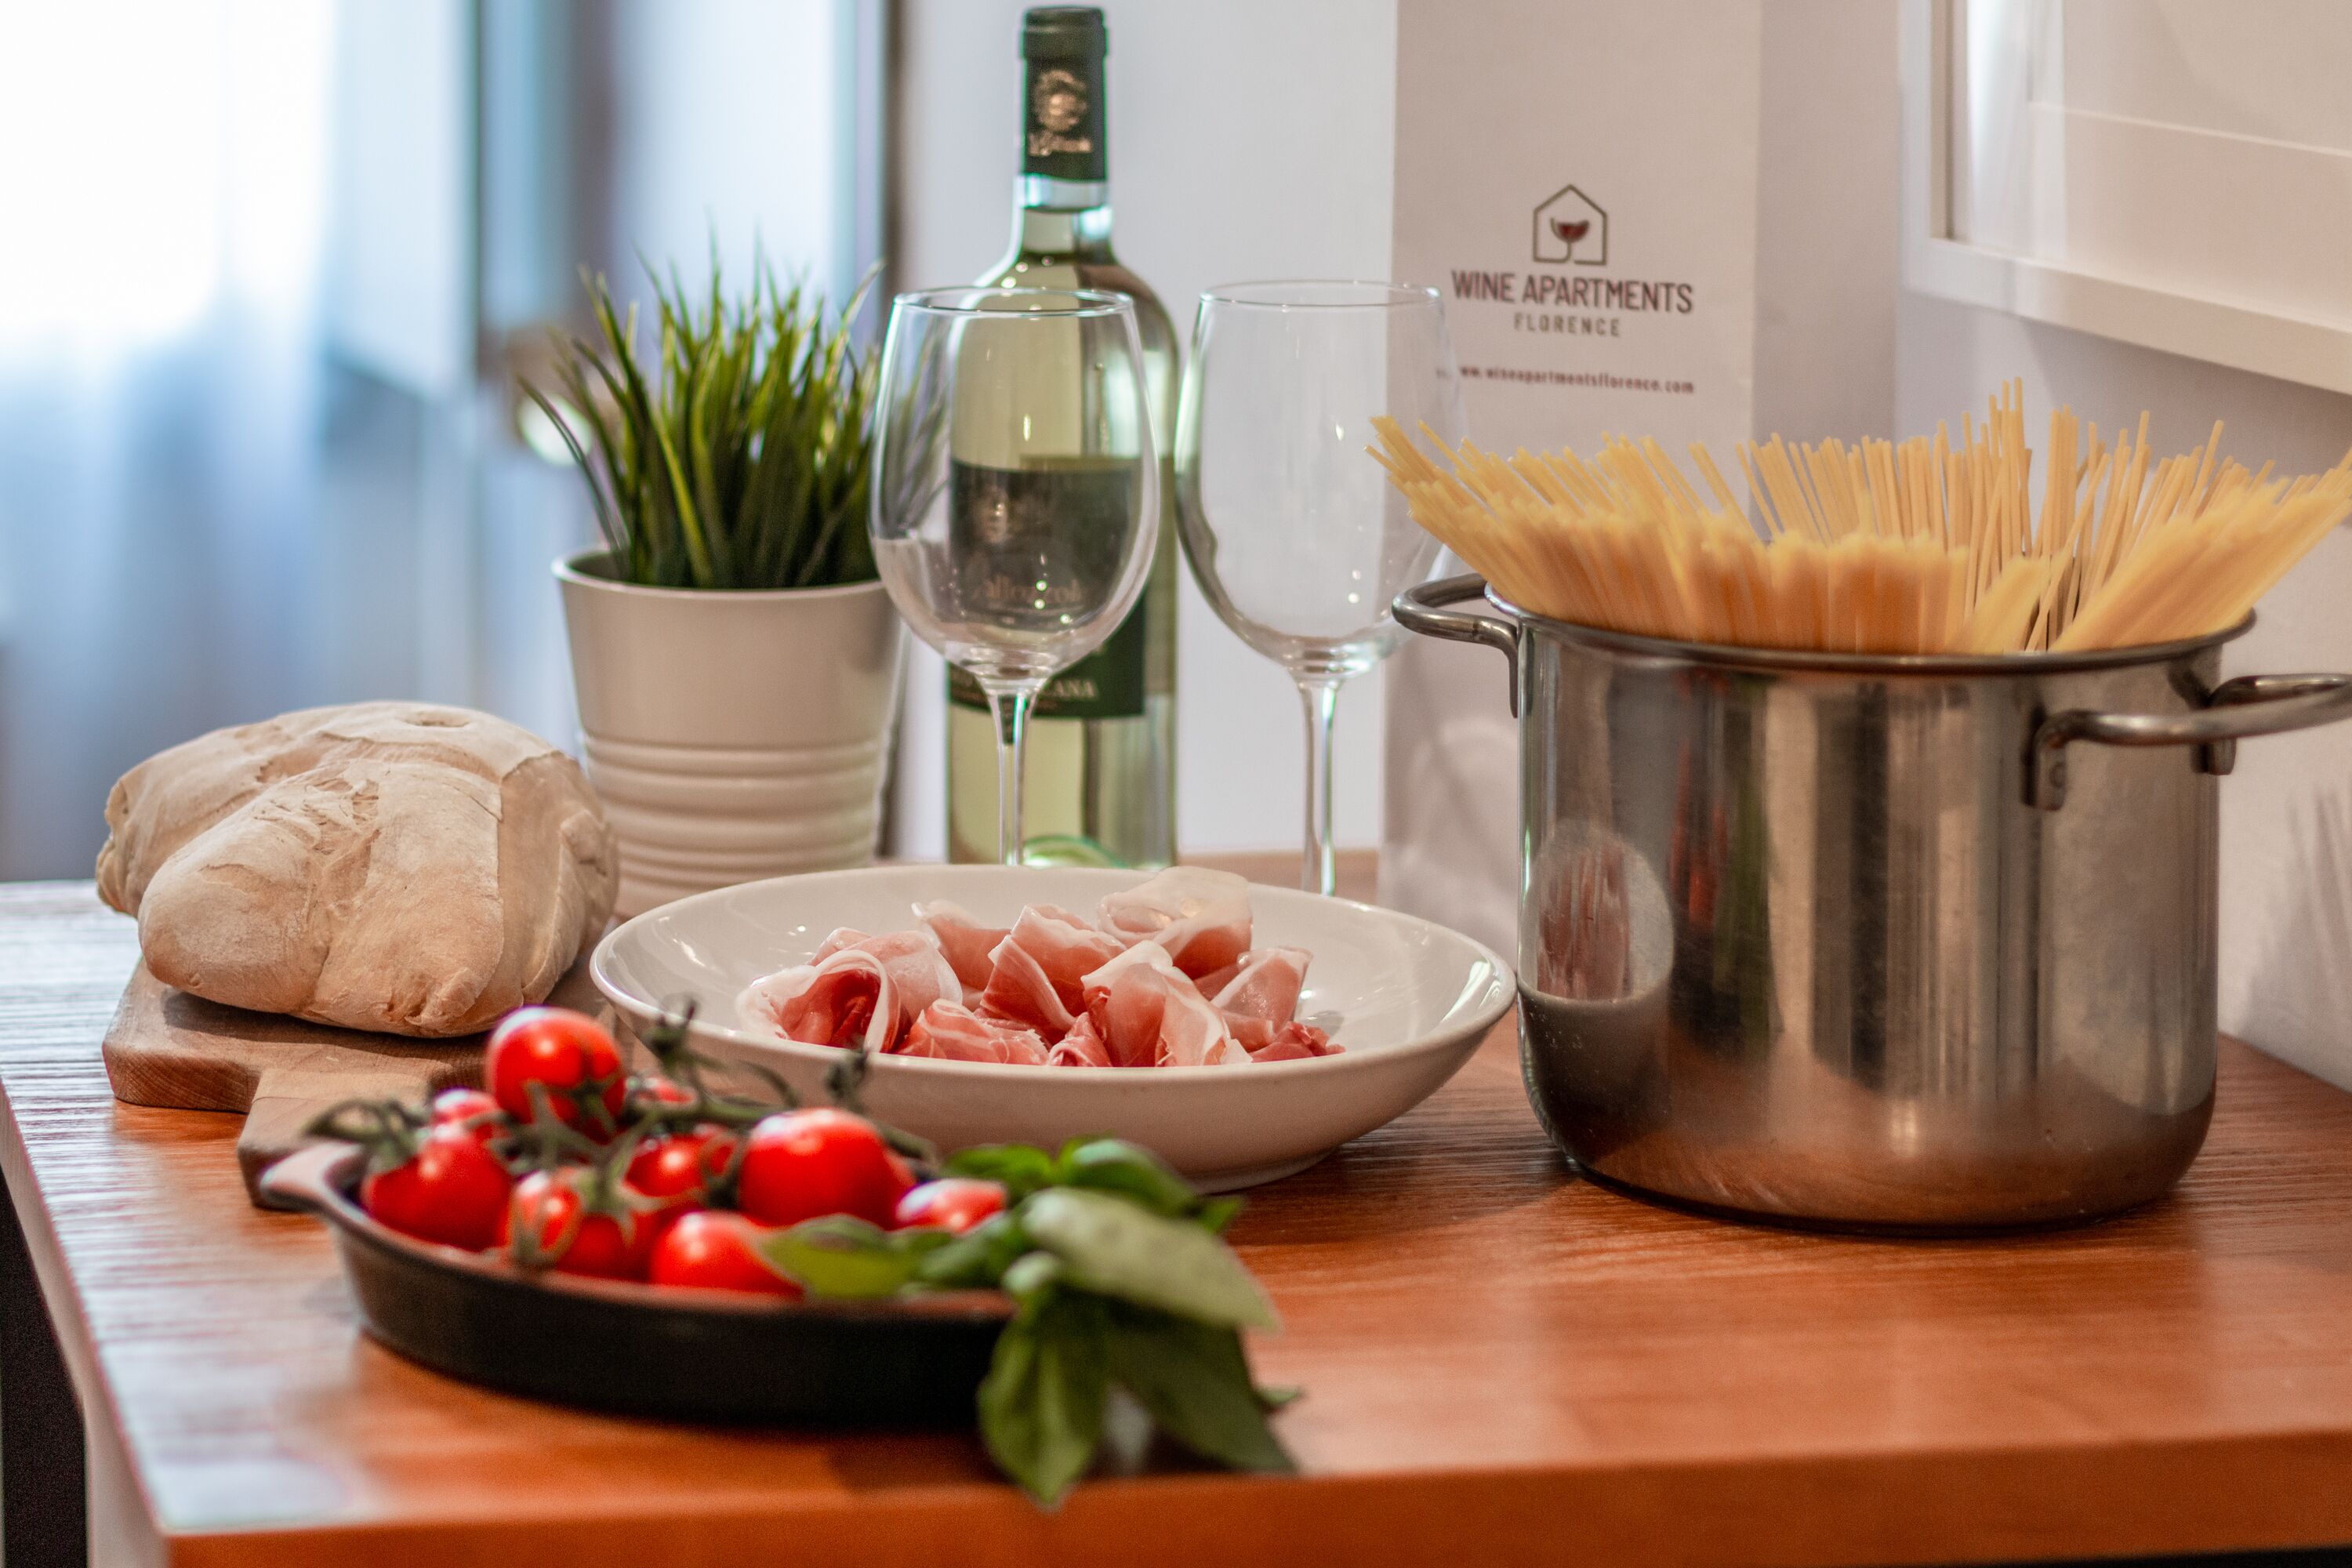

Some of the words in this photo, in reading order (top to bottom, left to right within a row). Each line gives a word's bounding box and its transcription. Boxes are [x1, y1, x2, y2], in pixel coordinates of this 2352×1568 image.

[1451, 270, 1515, 303] WINE
[1523, 274, 1693, 313] APARTMENTS
[1514, 314, 1620, 336] FLORENCE
